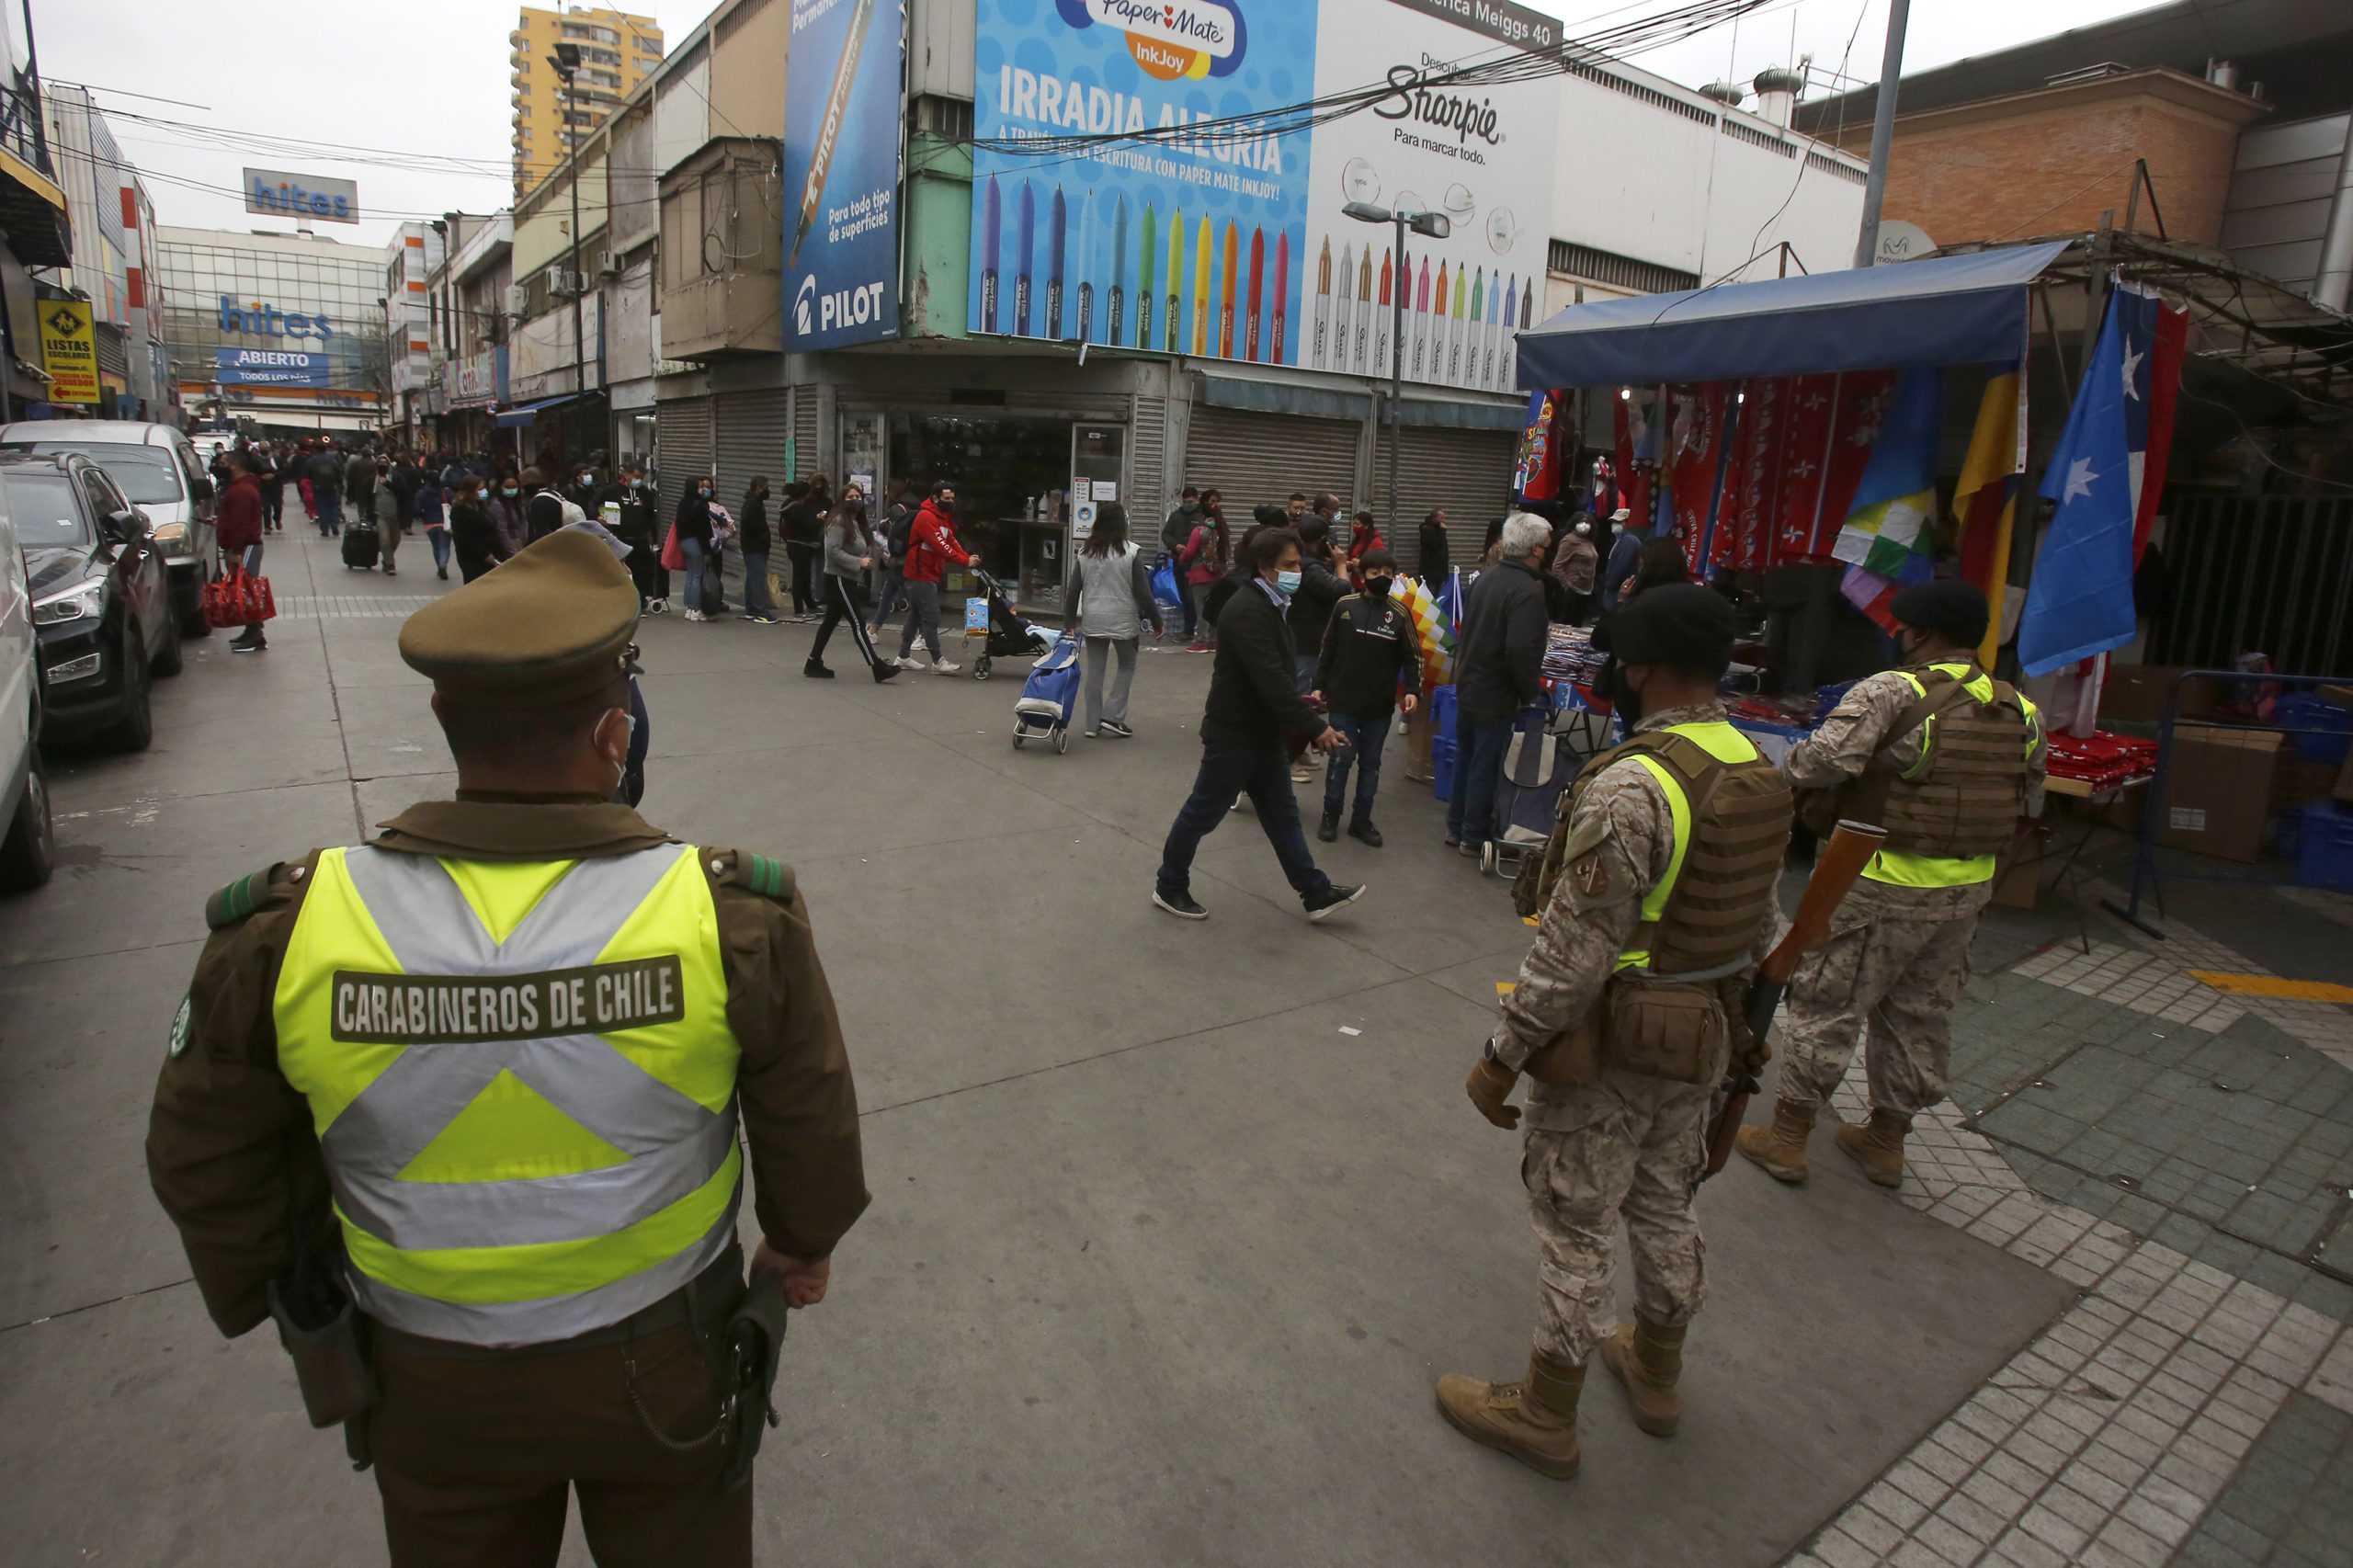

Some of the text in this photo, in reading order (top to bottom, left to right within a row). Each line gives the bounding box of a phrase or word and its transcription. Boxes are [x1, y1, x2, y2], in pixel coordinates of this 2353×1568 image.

[1104, 0, 1224, 44] Paper Mate
[1475, 0, 1529, 40] Meiggs
[1532, 24, 1551, 45] 40
[1136, 42, 1185, 74] InkJoy
[1000, 64, 1282, 176] IRRADIA ALEGRÍA
[1373, 64, 1500, 145] Sharpie
[1393, 128, 1486, 165] Para marcar todo.
[1093, 144, 1153, 173] ESCRITURA
[1154, 158, 1177, 179] CON
[1179, 164, 1211, 187] PAPER
[1213, 171, 1240, 192] MATE
[1242, 176, 1280, 201] INKJOY!
[254, 176, 348, 217] hites
[829, 187, 891, 226] Para todo tipo
[829, 210, 889, 244] de superficies
[221, 293, 334, 340] hites
[821, 280, 884, 332] PILOT
[46, 339, 90, 352] LISTAS
[239, 350, 310, 367] ABIERTO
[239, 371, 269, 381] TODOS
[338, 966, 676, 1035] CARABINEROS DE CHILE
